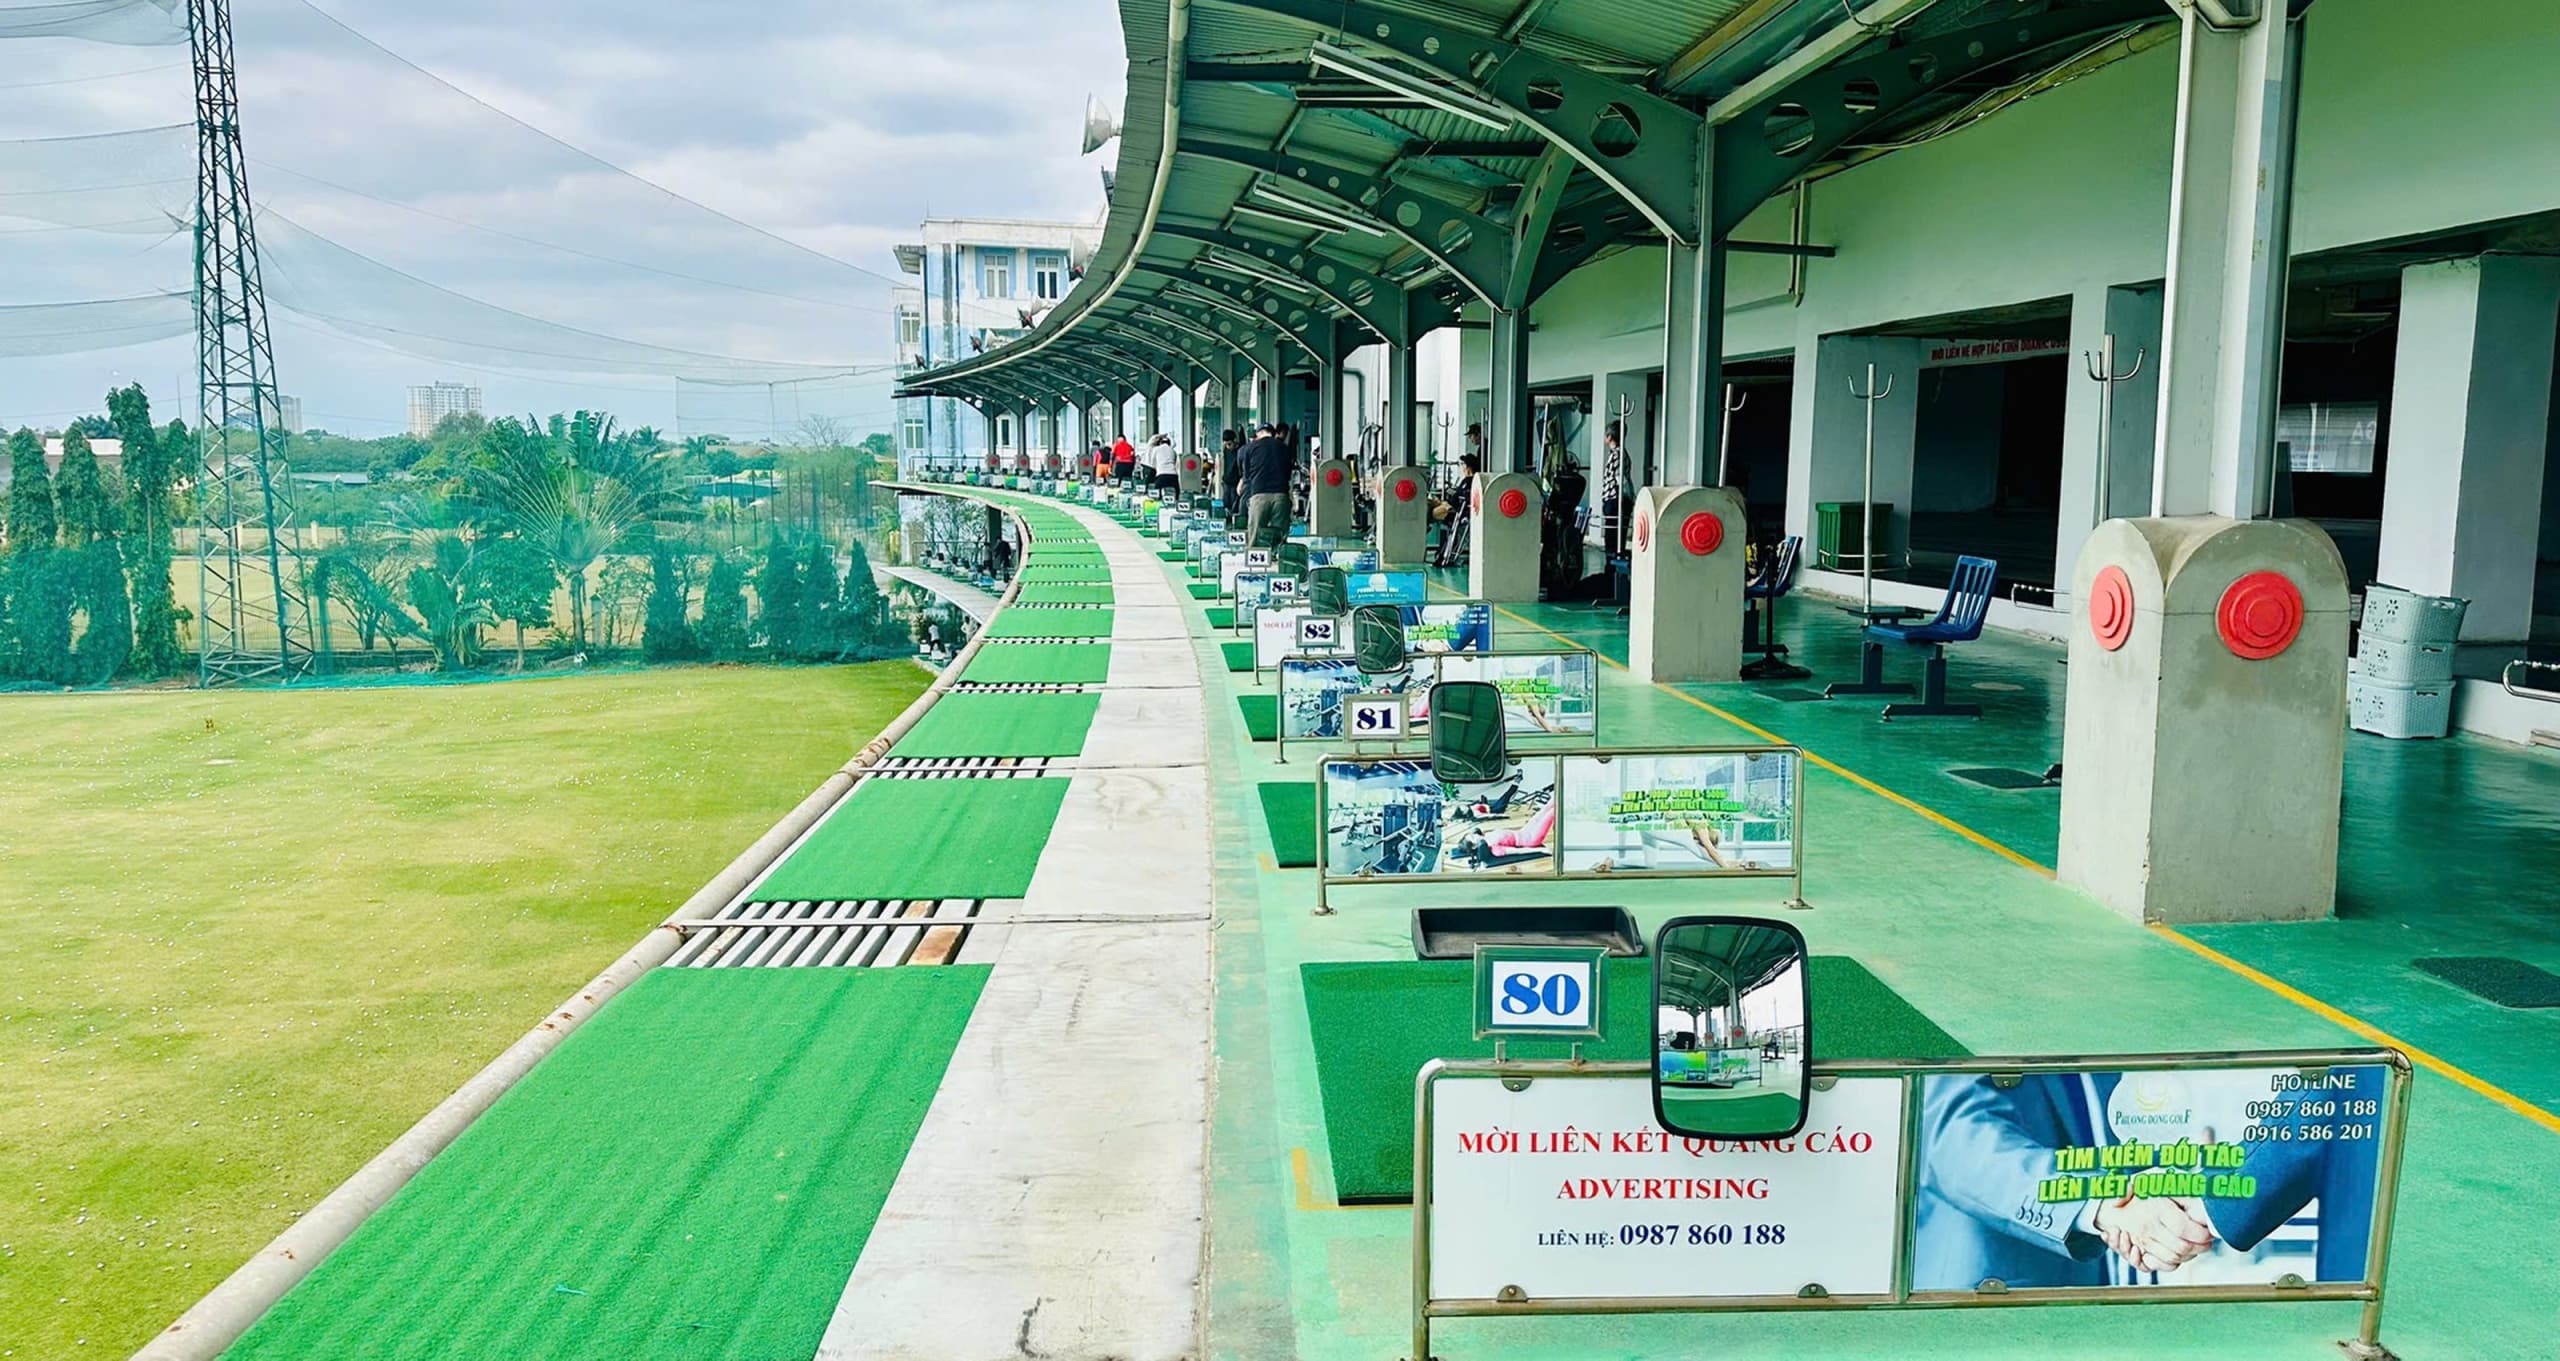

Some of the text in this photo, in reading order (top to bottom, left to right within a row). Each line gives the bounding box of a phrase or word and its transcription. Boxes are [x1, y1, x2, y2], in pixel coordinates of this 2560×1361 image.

[1230, 534, 1244, 543] 85
[1249, 552, 1266, 562] 84
[1271, 580, 1293, 593] 83
[1304, 623, 1332, 640] 82
[1356, 706, 1396, 730] 81
[1500, 972, 1581, 1016] 80
[2271, 1073, 2357, 1092] HOTLINE
[2246, 1099, 2377, 1119] 0987 860 188
[1458, 1126, 1520, 1153] MỜI
[1530, 1125, 1602, 1153] LIÊN
[1612, 1125, 1675, 1153] KẾT
[1805, 1125, 1873, 1154] CÁO
[2244, 1123, 2373, 1142] 0916 586 201
[2055, 1136, 2245, 1171] TÌM KIẾM ĐỐI TÁC
[1557, 1177, 1769, 1200] ADVERTISING
[2038, 1167, 2257, 1203] LIÊN KẾT QUẢNG CÁO
[1538, 1223, 1786, 1249] LIÊN HỆ: 0987 860 188
